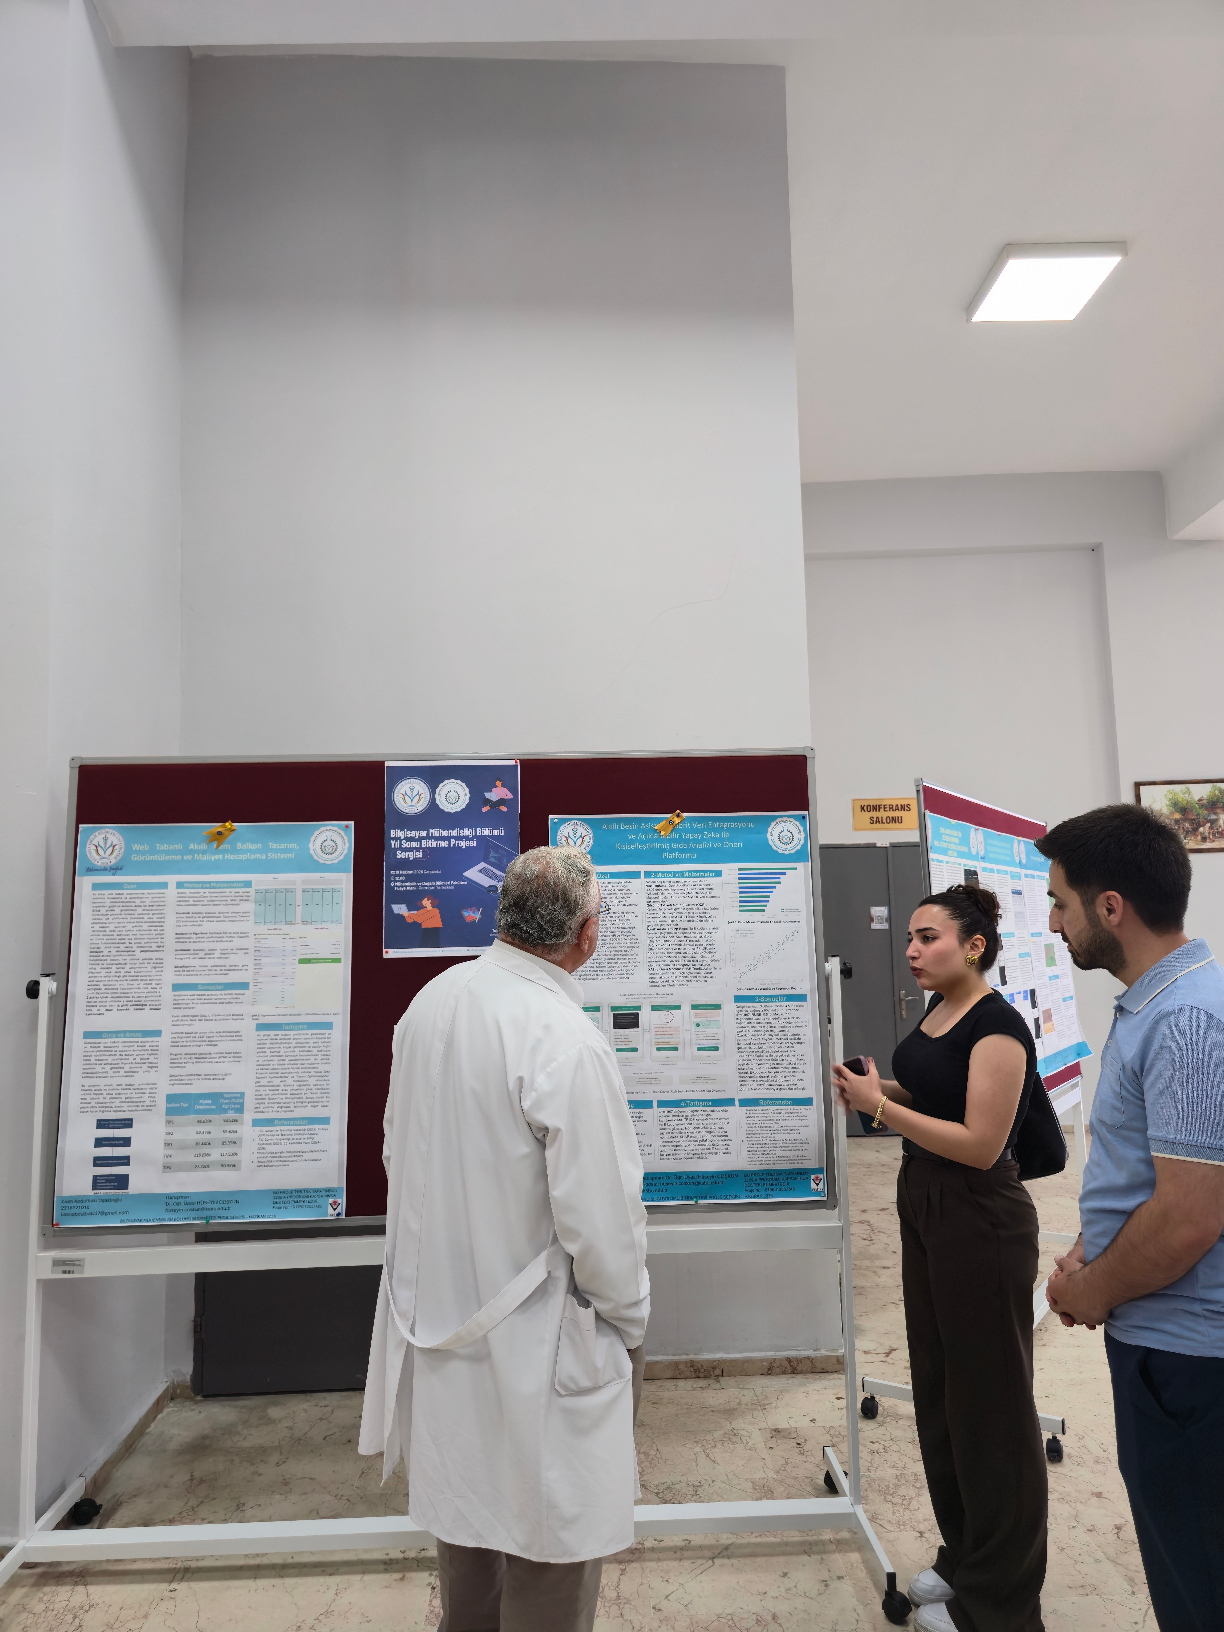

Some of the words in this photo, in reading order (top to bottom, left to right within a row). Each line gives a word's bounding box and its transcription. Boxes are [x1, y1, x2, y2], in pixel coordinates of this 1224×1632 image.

[860, 804, 911, 812] KONFERANS
[869, 816, 903, 824] SALONU
[620, 822, 638, 830] Besin
[692, 821, 706, 829] Veri
[390, 829, 427, 839] Bilgisayar
[429, 828, 475, 838] Mühendisliği
[477, 827, 504, 836] Bölümü
[681, 831, 702, 839] Yapay
[131, 843, 150, 851] Web
[391, 840, 400, 848] Yıl
[402, 840, 420, 848] Sonu
[422, 839, 449, 848] Bitirme
[450, 838, 477, 849] Projesi
[689, 841, 712, 849] Analizi
[723, 839, 743, 848] Öneri
[194, 853, 223, 861] Maliyet
[224, 852, 266, 861] Hesaplama
[397, 850, 423, 860] Sergisi
